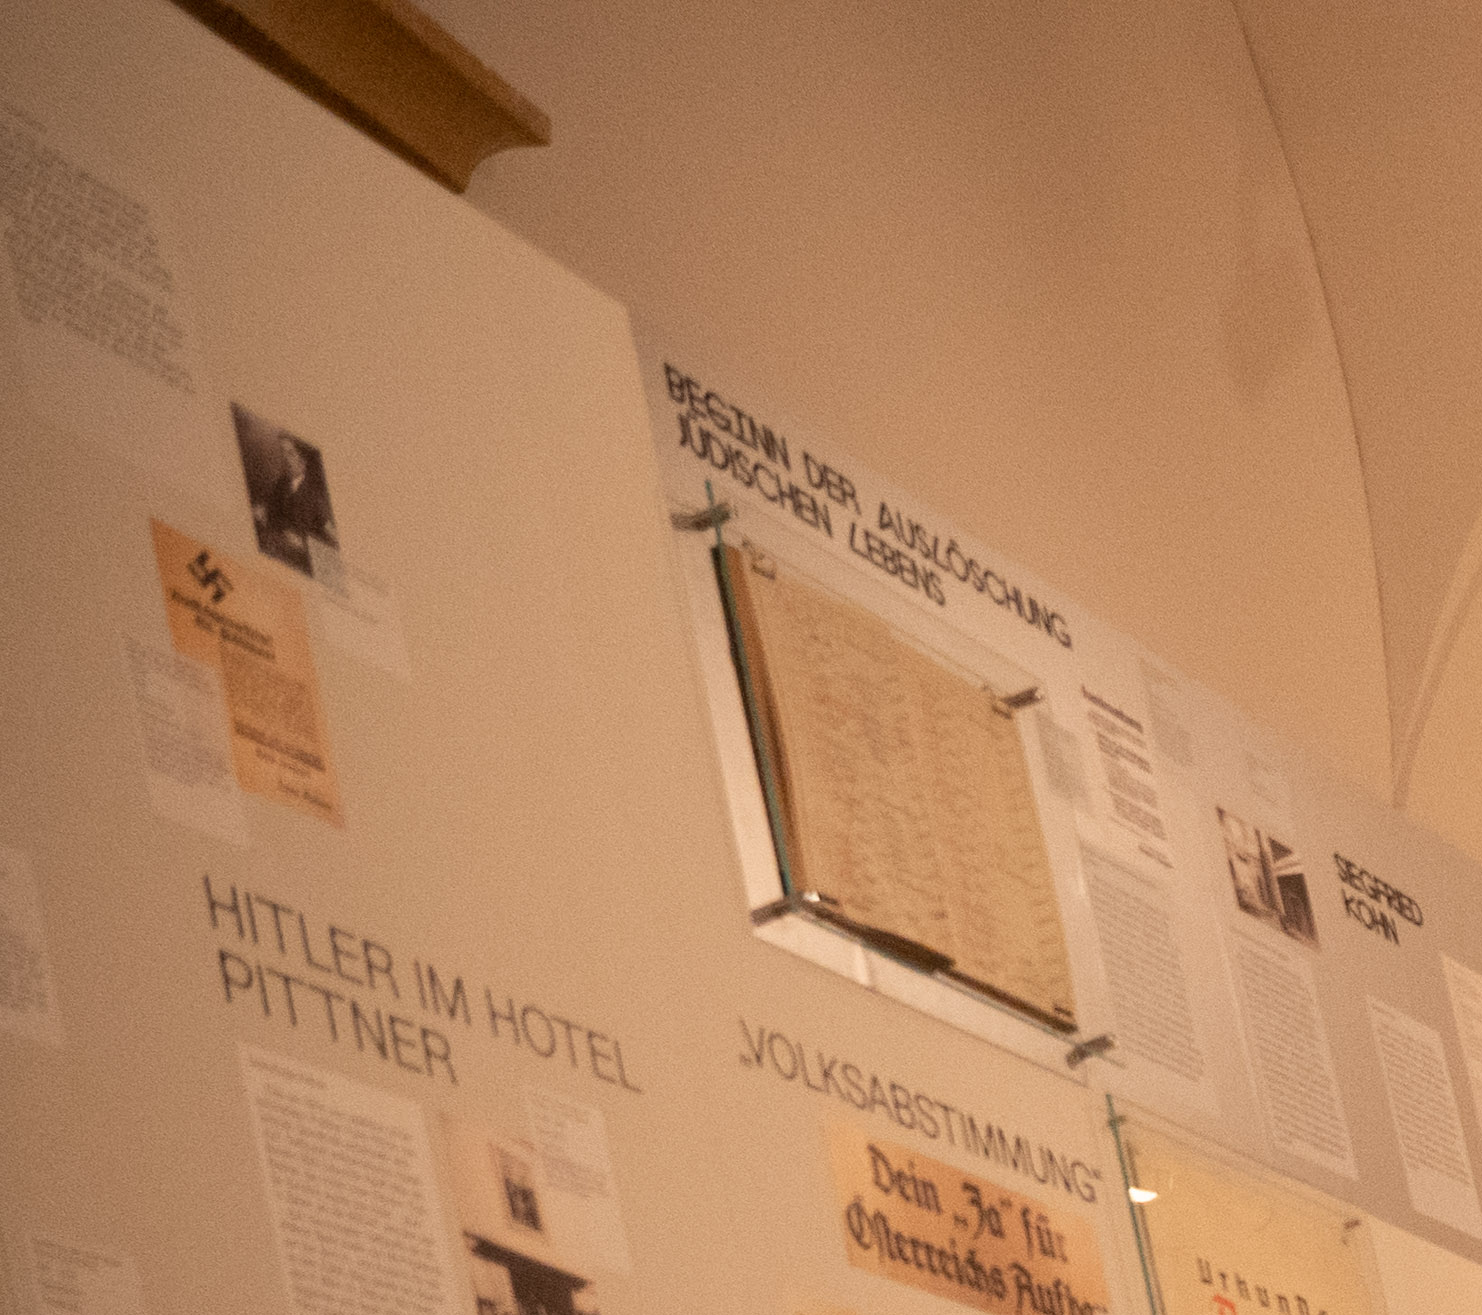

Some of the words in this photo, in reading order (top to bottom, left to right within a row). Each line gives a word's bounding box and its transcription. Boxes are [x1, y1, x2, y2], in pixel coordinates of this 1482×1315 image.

[664, 362, 791, 470] BEGINN
[803, 451, 861, 516] DER
[879, 501, 1073, 649] AUSLÖSCHUNG
[677, 407, 833, 538] JÜDISCHEN
[849, 522, 946, 607] LEBENS
[202, 875, 400, 999] HITLER
[413, 960, 471, 1027] IM
[485, 988, 644, 1095] HOTEL
[1341, 888, 1400, 946] KOHN
[218, 949, 459, 1086] PITTNER
